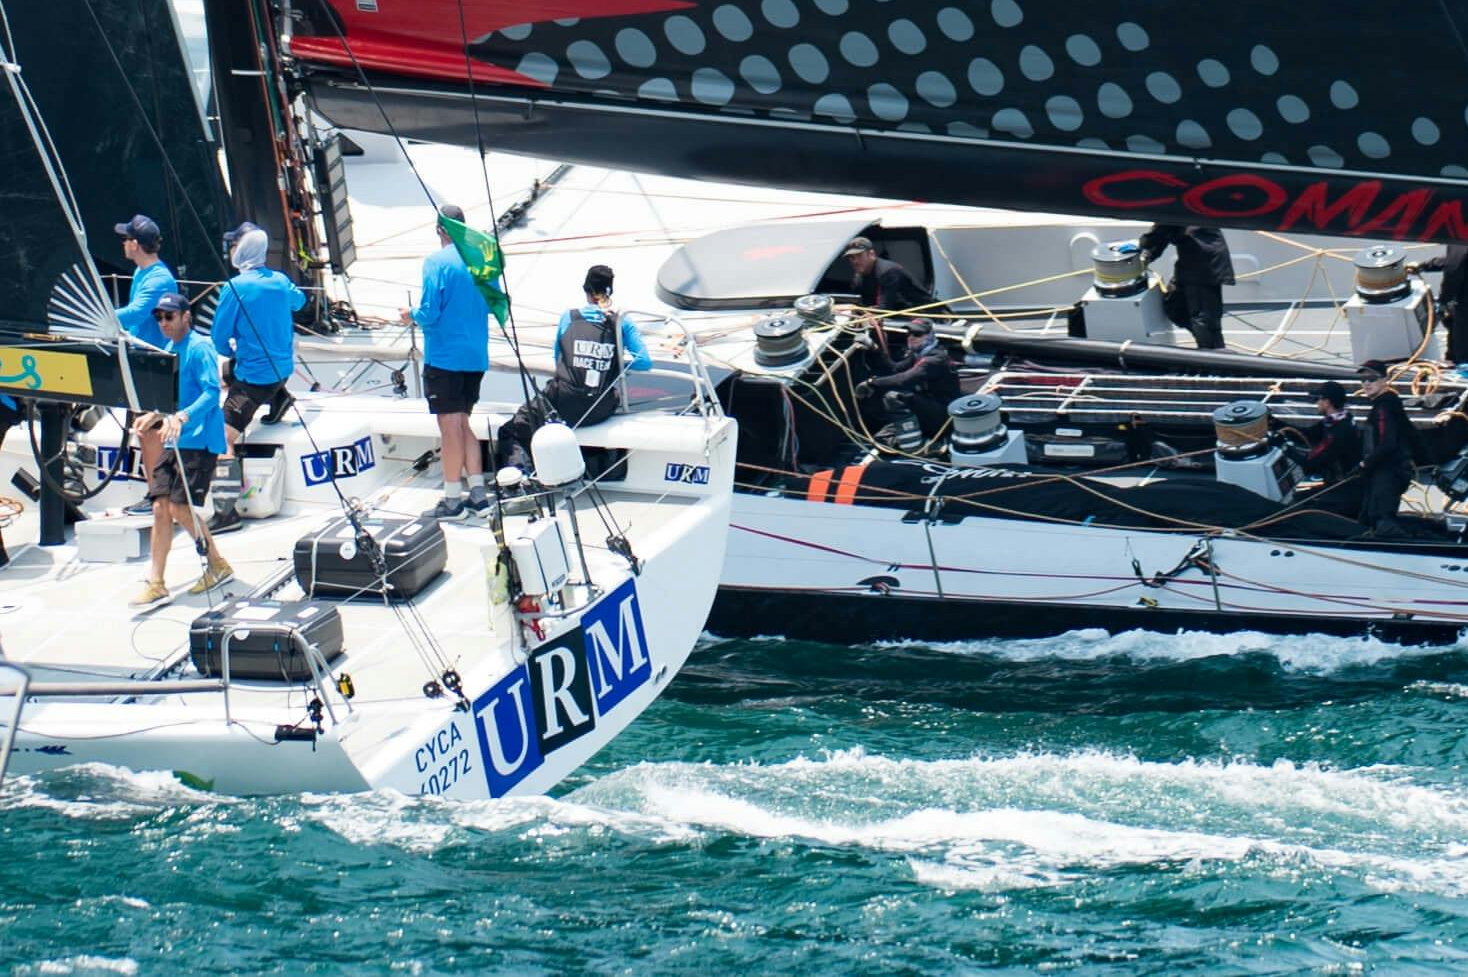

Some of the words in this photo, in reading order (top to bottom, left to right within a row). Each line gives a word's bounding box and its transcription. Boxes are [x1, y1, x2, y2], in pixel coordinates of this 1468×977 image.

[301, 438, 375, 483] URM
[665, 464, 709, 483] URM
[475, 590, 650, 780] URM
[415, 721, 462, 773] CYCA
